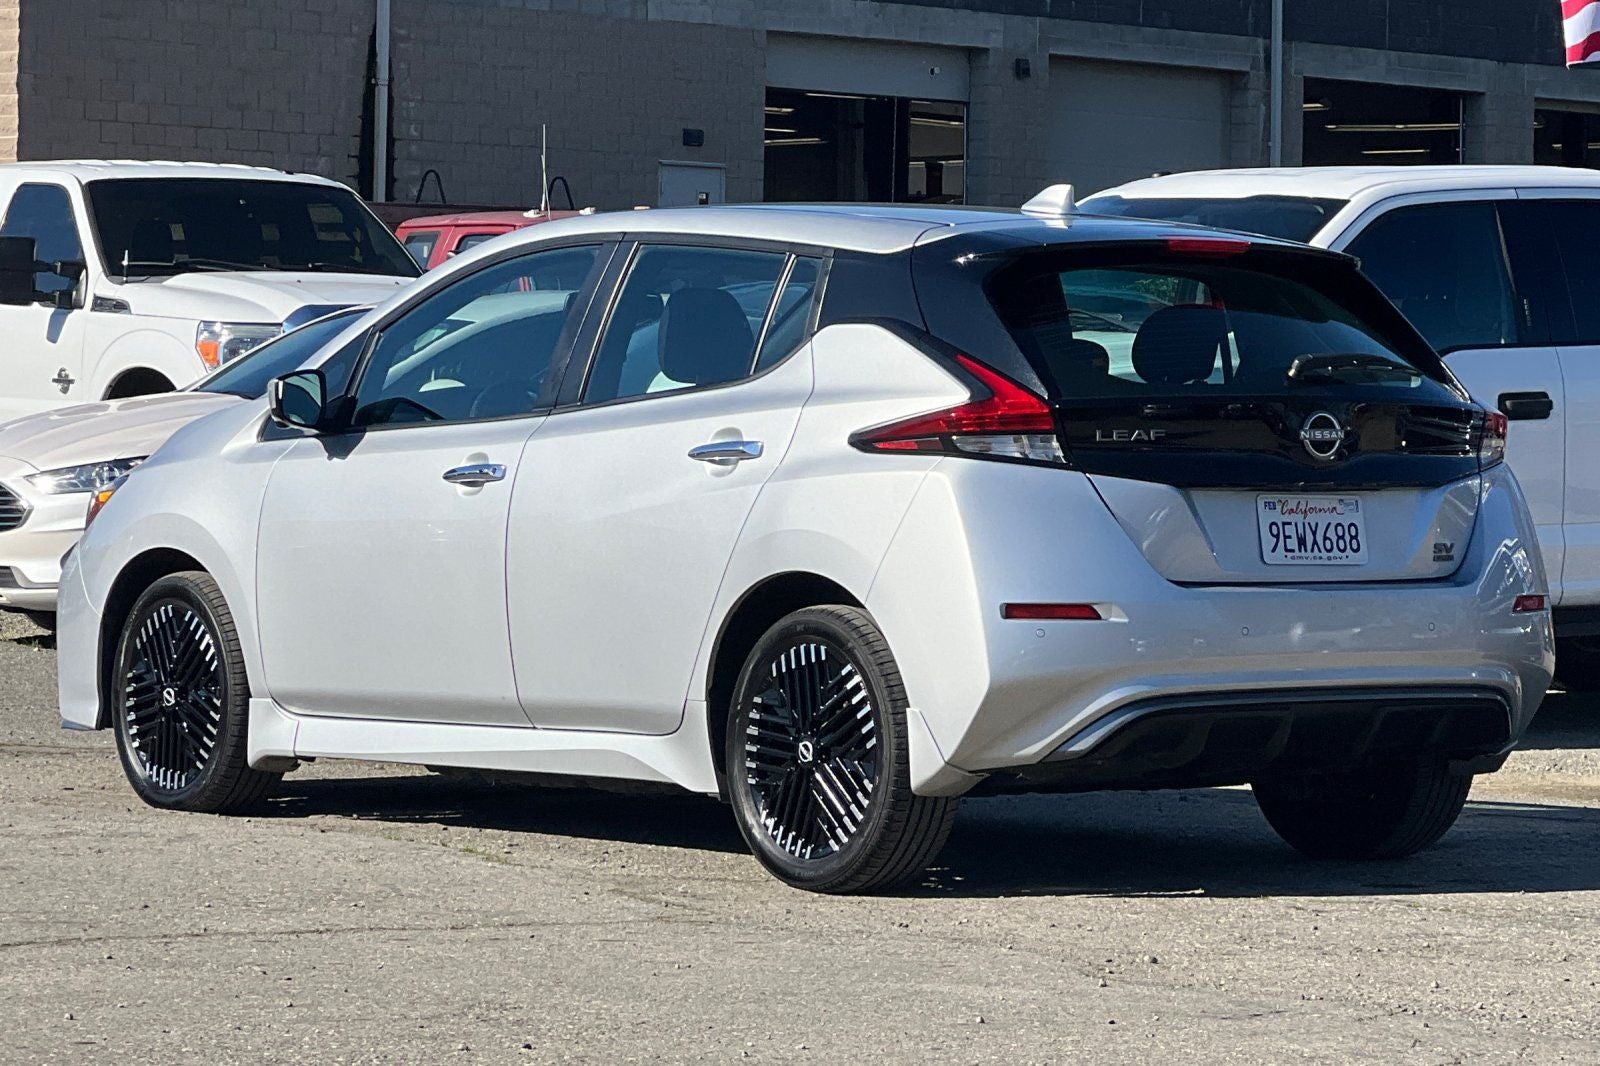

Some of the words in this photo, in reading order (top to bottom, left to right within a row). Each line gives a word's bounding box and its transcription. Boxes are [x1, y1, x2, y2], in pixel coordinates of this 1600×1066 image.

[1095, 429, 1168, 442] LEAF
[1300, 430, 1345, 440] NISSAN
[1279, 499, 1344, 519] California
[1268, 521, 1361, 553] 9EWX688
[1433, 543, 1454, 554] SV
